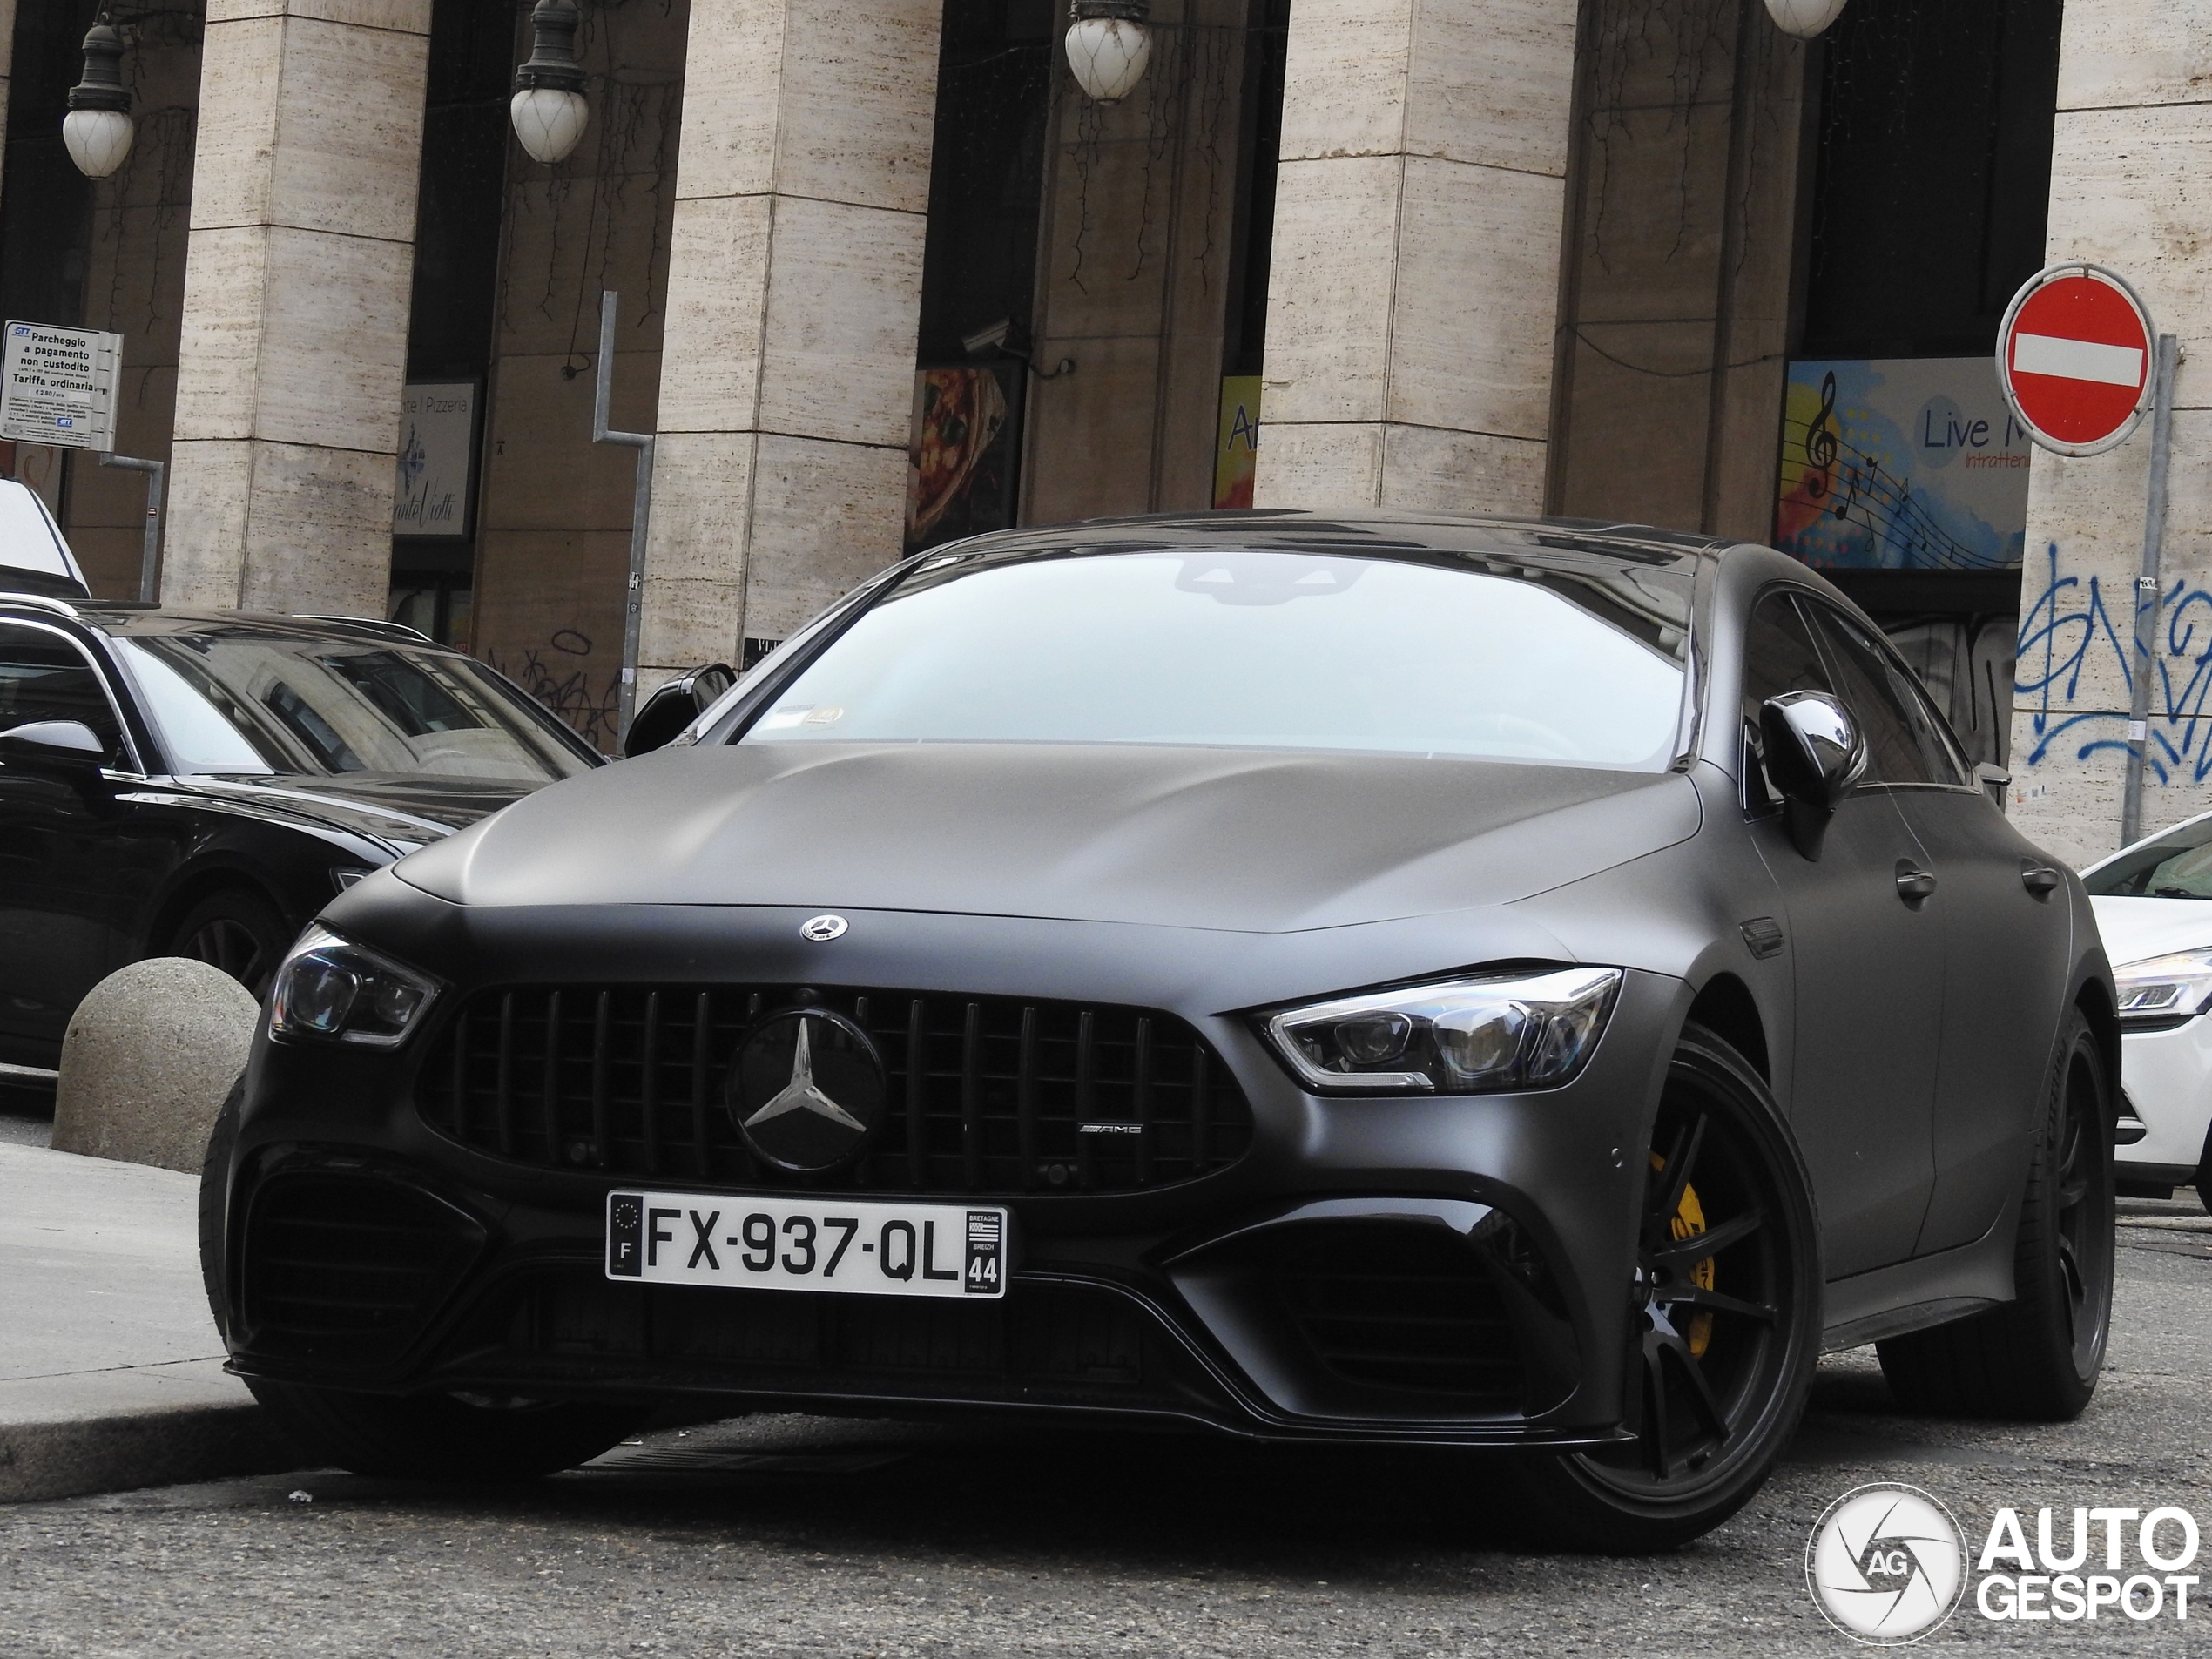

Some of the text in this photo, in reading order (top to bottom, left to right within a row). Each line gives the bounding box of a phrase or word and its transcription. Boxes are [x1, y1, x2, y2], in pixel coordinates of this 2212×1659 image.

[32, 333, 86, 347] Parcheggio
[35, 347, 90, 360] pagamento
[44, 361, 90, 372] custodito
[13, 374, 93, 391] Tariffa ordinaria
[427, 397, 467, 413] Pizzeria
[1925, 409, 1989, 448] Live
[620, 1242, 631, 1259] F
[647, 1207, 959, 1283] FX-937-QL
[968, 1256, 997, 1283] 44
